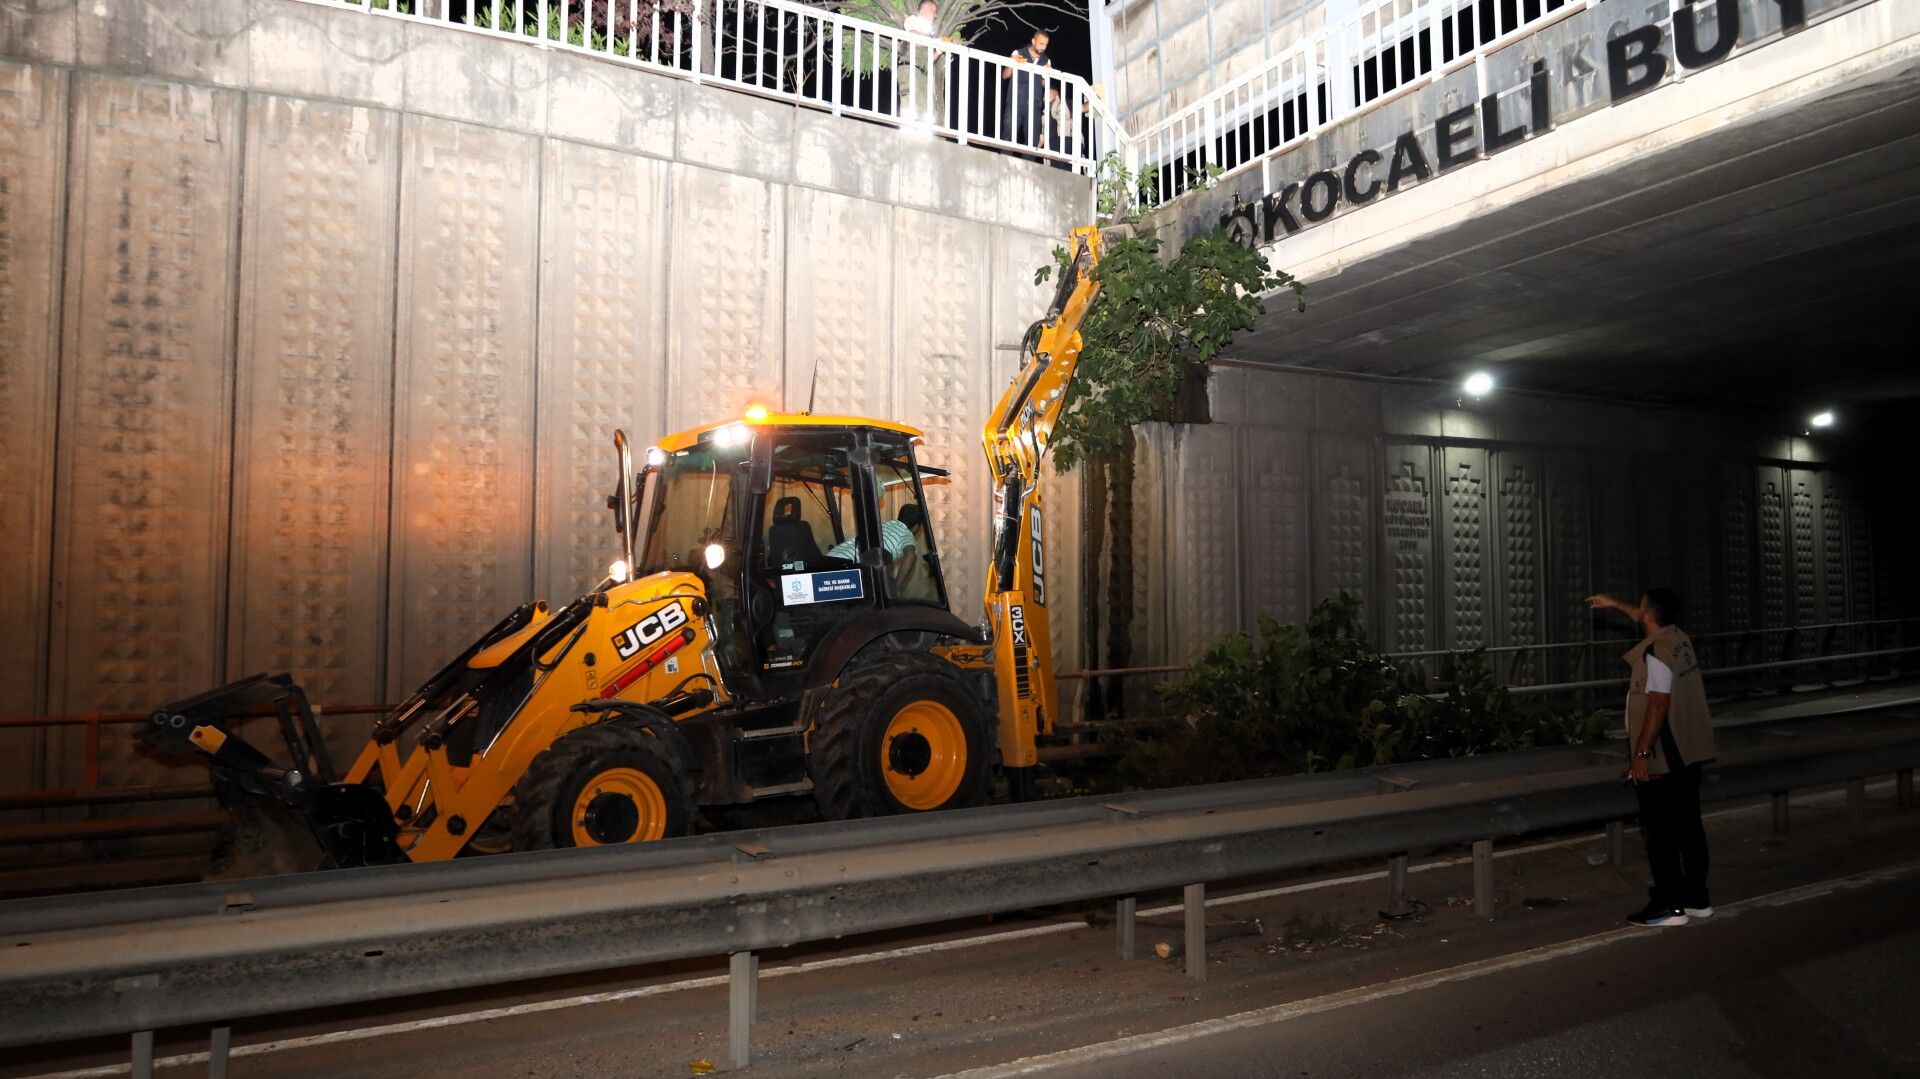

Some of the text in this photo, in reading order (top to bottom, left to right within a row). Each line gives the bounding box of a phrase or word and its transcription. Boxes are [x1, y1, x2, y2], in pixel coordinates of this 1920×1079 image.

[1262, 57, 1550, 243] KOCAELİ
[1031, 508, 1045, 604] JCB
[619, 602, 686, 657] JCB
[1011, 607, 1025, 644] 3CX
